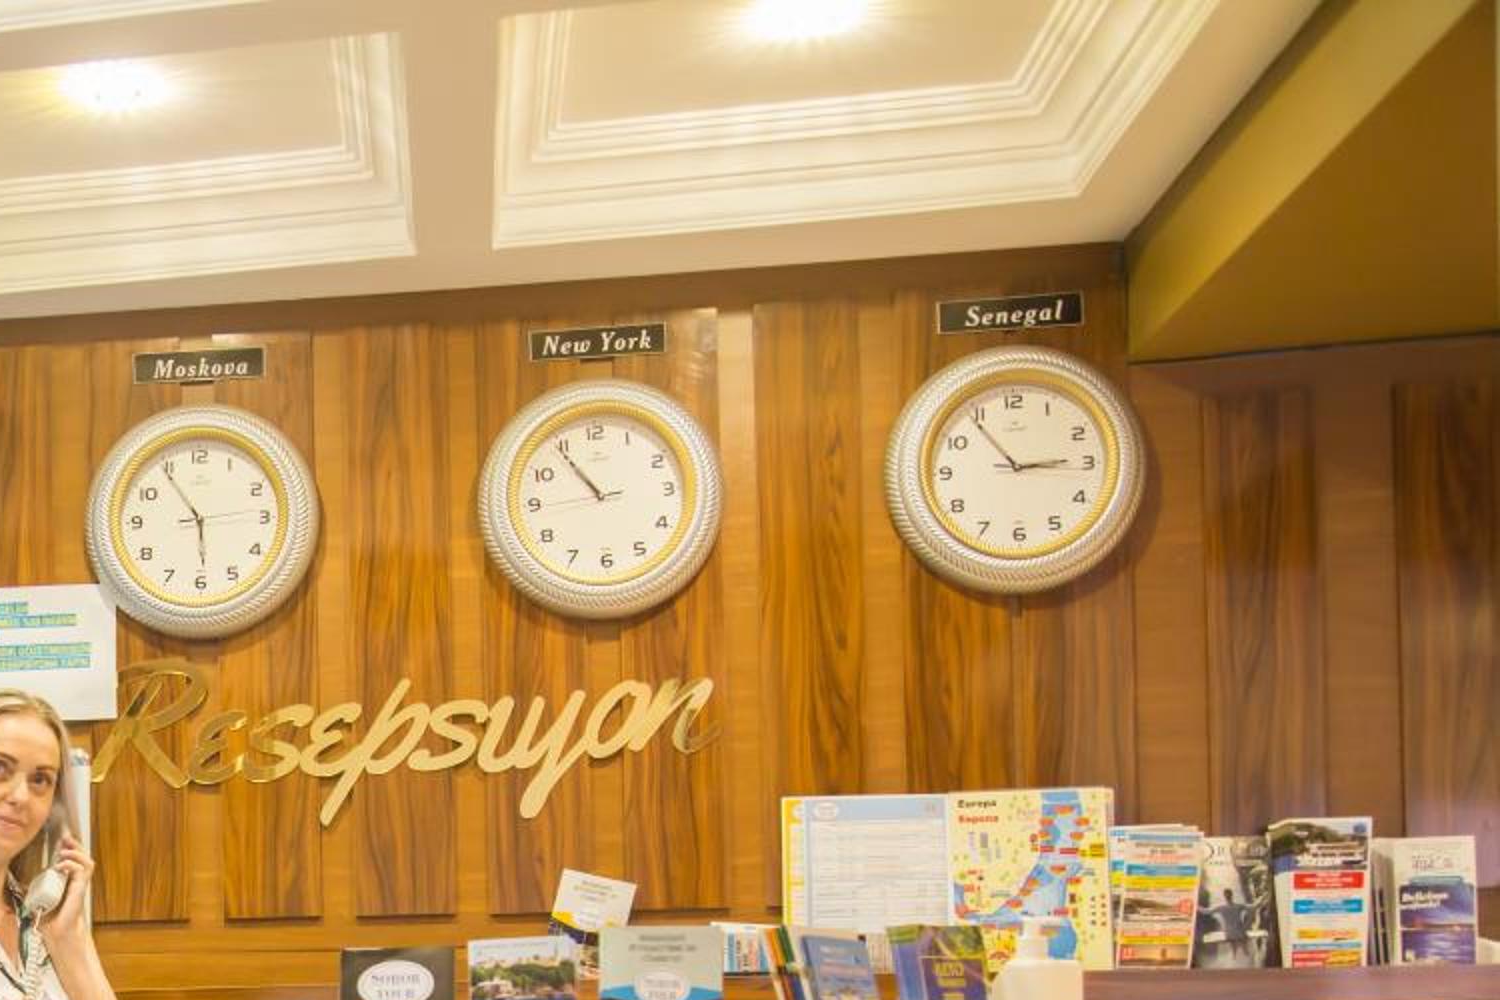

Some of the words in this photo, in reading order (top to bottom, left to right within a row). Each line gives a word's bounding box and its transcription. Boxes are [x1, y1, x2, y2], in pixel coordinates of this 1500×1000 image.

[964, 299, 1063, 327] Senegal
[542, 335, 592, 356] New
[600, 329, 652, 352] York
[153, 357, 249, 379] Moskova
[1004, 396, 1023, 409] 12
[586, 426, 603, 440] 12
[1072, 427, 1085, 440] 2
[948, 436, 968, 450] 10
[192, 450, 208, 464] 12
[651, 455, 663, 468] 2
[1083, 456, 1095, 469] 3
[535, 468, 554, 482] 10
[940, 467, 952, 480] 9
[140, 488, 158, 501] 10
[251, 483, 262, 496] 2
[663, 482, 674, 496] 3
[1073, 490, 1085, 503] 4
[528, 498, 541, 512] 9
[951, 499, 964, 512] 8
[131, 516, 143, 529] 9
[260, 511, 270, 524] 3
[656, 516, 668, 528] 4
[1049, 516, 1061, 530] 5
[977, 522, 990, 536] 7
[1013, 528, 1026, 541] 6
[541, 530, 553, 542] 8
[140, 548, 152, 560] 8
[249, 544, 260, 555] 4
[634, 542, 646, 556] 5
[567, 550, 579, 567] 7
[601, 554, 613, 568] 6
[164, 570, 175, 583] 7
[228, 567, 239, 580] 5
[196, 576, 206, 589] 6
